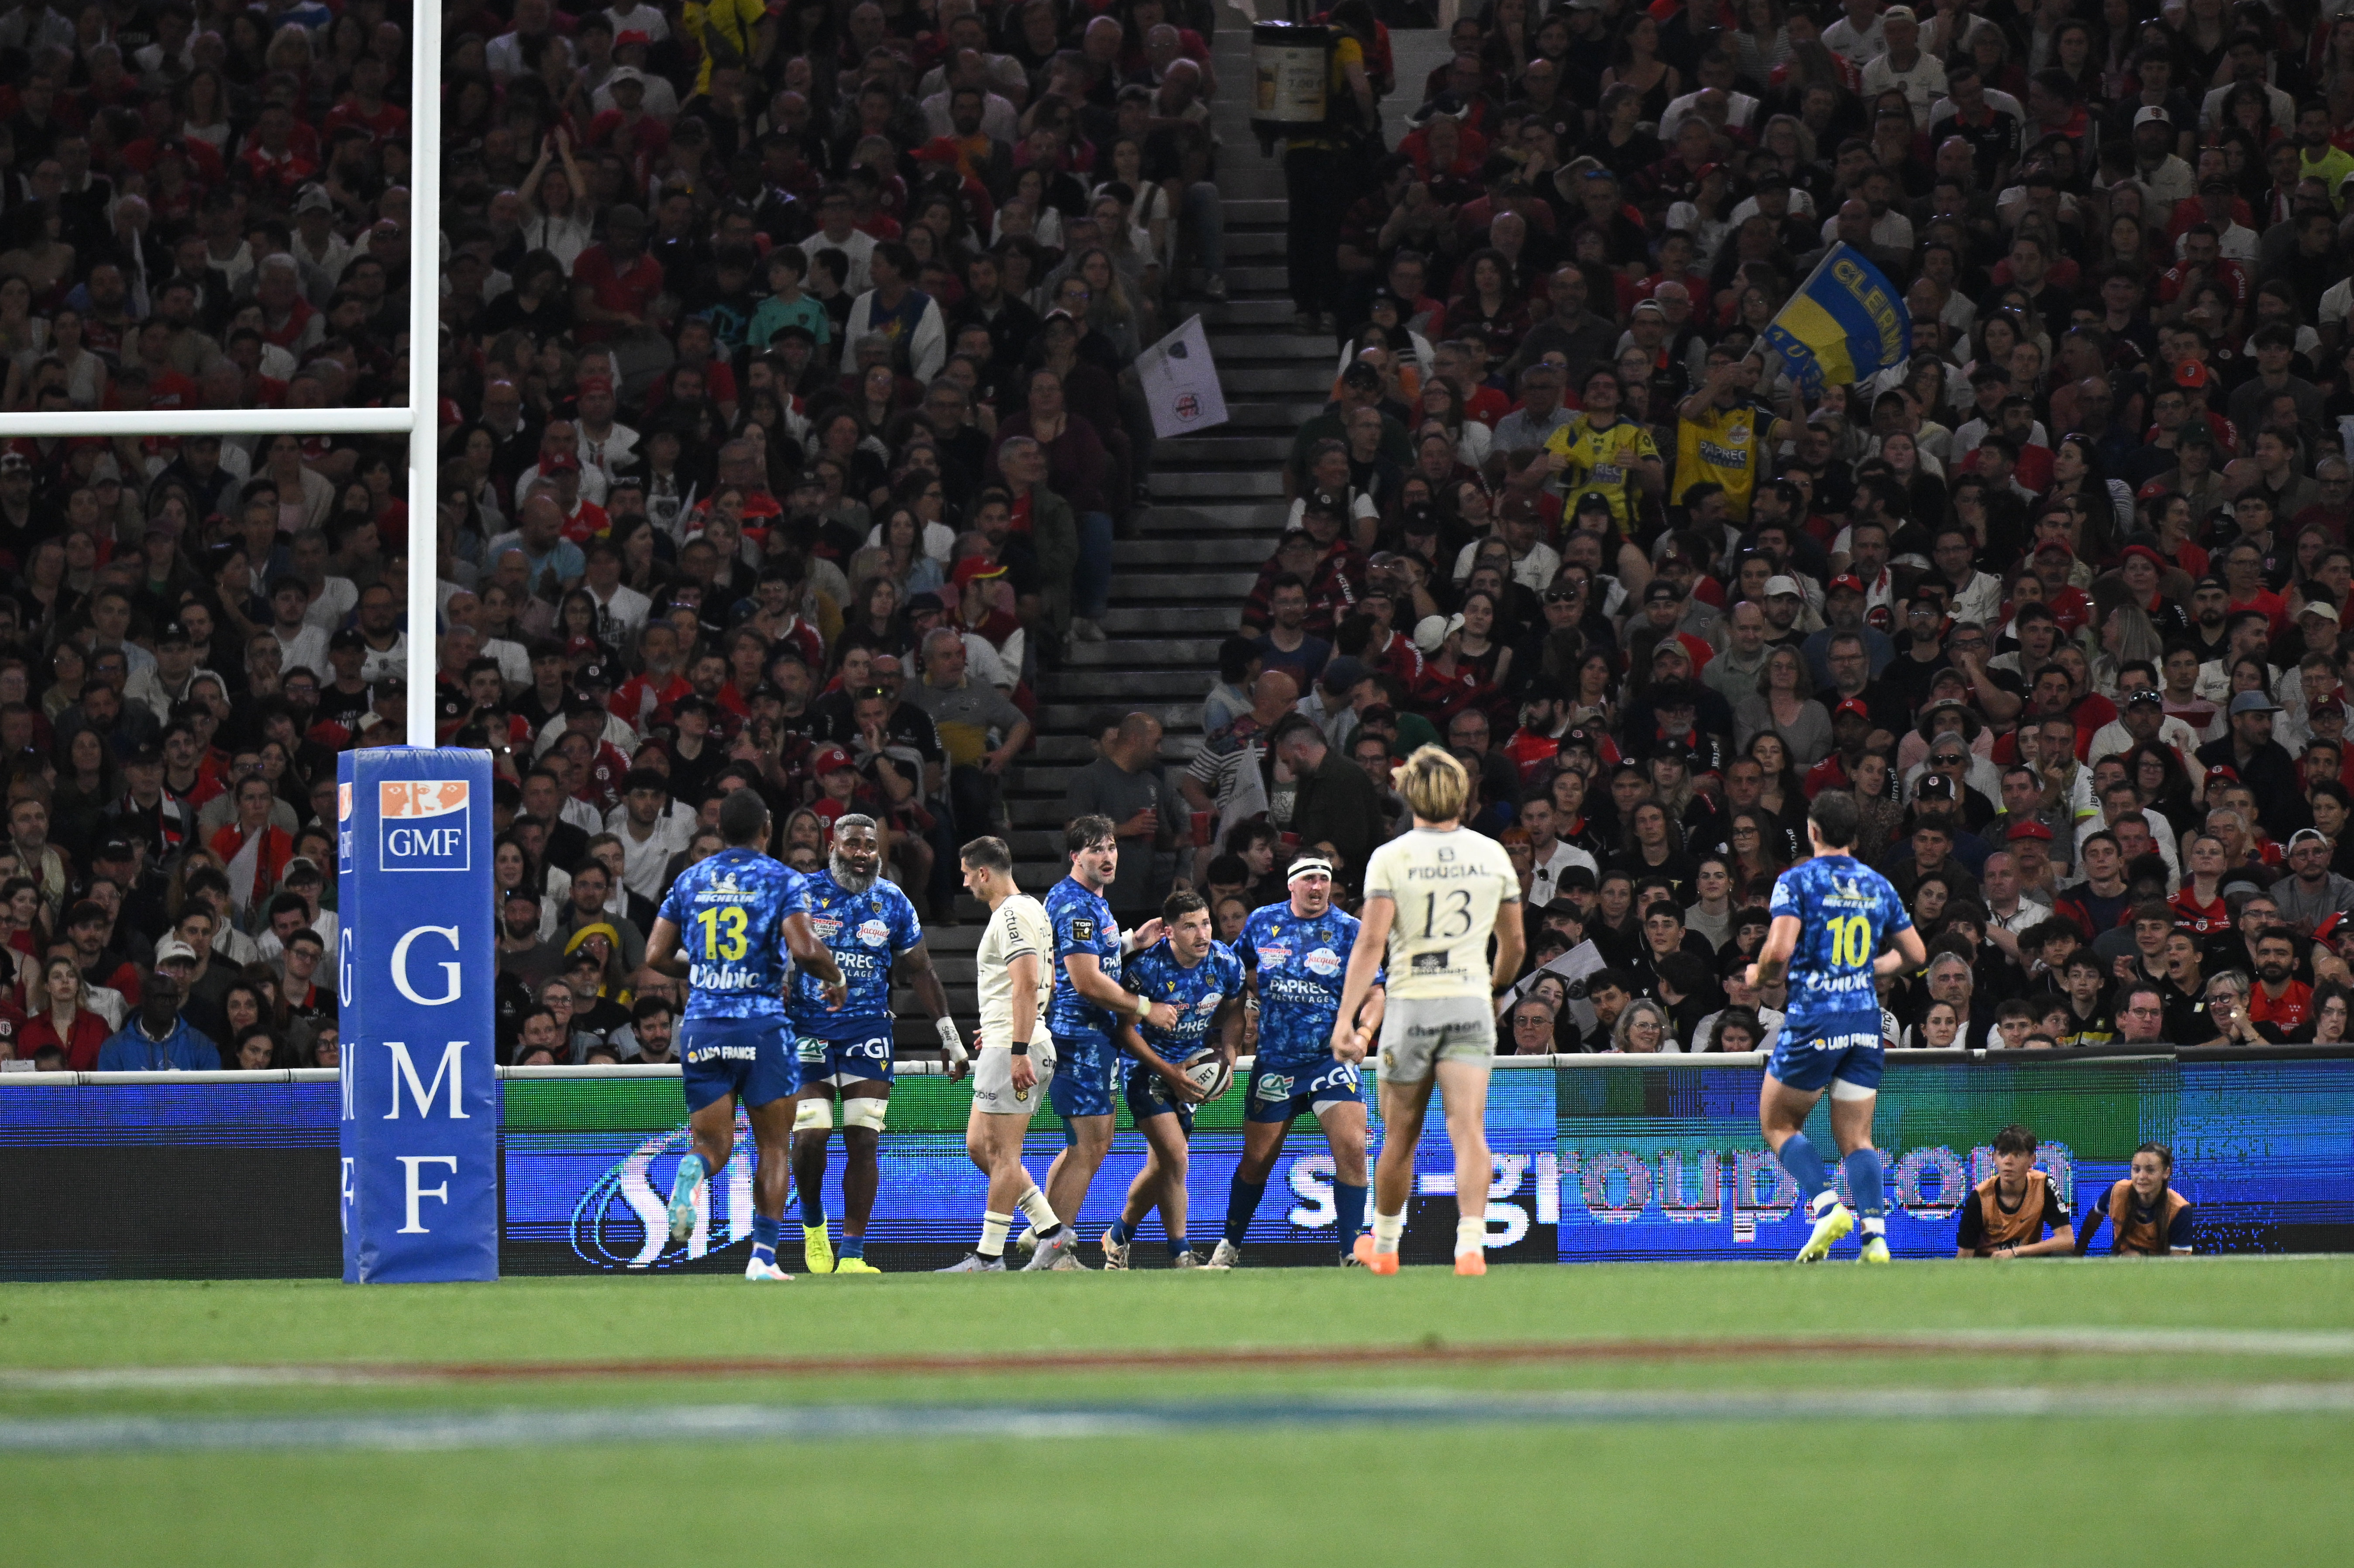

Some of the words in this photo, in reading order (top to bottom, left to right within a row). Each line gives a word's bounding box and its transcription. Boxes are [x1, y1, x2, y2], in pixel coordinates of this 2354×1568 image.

[388, 829, 461, 856] GMF
[1408, 863, 1490, 880] FIDUCIAL
[694, 894, 755, 903] MICHELIN
[1422, 888, 1472, 939] 13
[698, 906, 748, 961] 13
[857, 923, 890, 939] Jacquet
[1826, 916, 1871, 967] 10
[834, 951, 874, 969] PREC
[1306, 952, 1340, 967] Jacquet
[690, 963, 759, 990] Volvic
[1270, 978, 1328, 994] PAPREC
[1271, 992, 1329, 1004] RECYCLAGE
[722, 1046, 757, 1061] FRANCE
